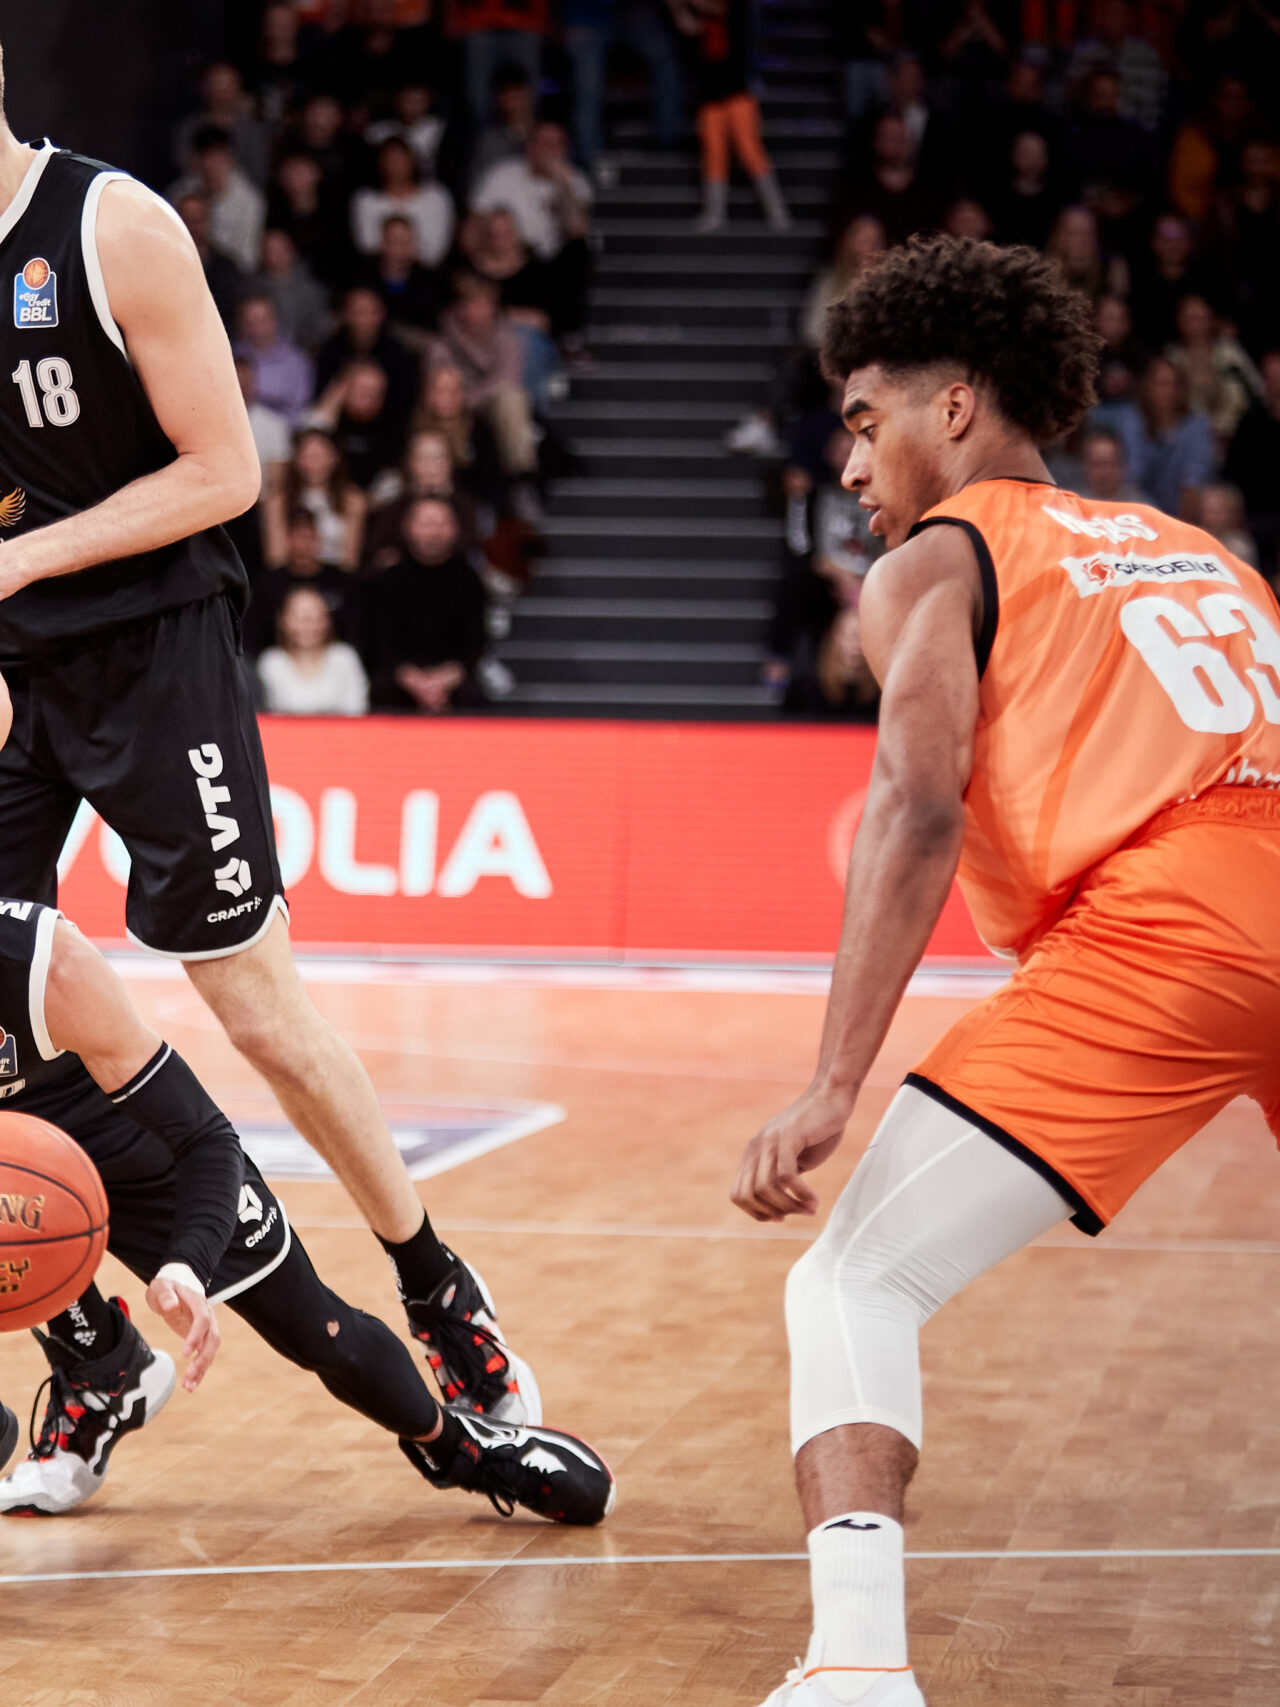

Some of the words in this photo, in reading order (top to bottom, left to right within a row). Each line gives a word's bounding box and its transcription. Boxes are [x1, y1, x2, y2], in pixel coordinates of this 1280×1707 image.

[20, 307, 52, 322] BBL
[12, 357, 81, 427] 18
[1120, 593, 1280, 734] 63
[188, 743, 241, 852] VTG
[207, 901, 254, 923] CRAFT
[245, 1211, 275, 1248] CRAFT
